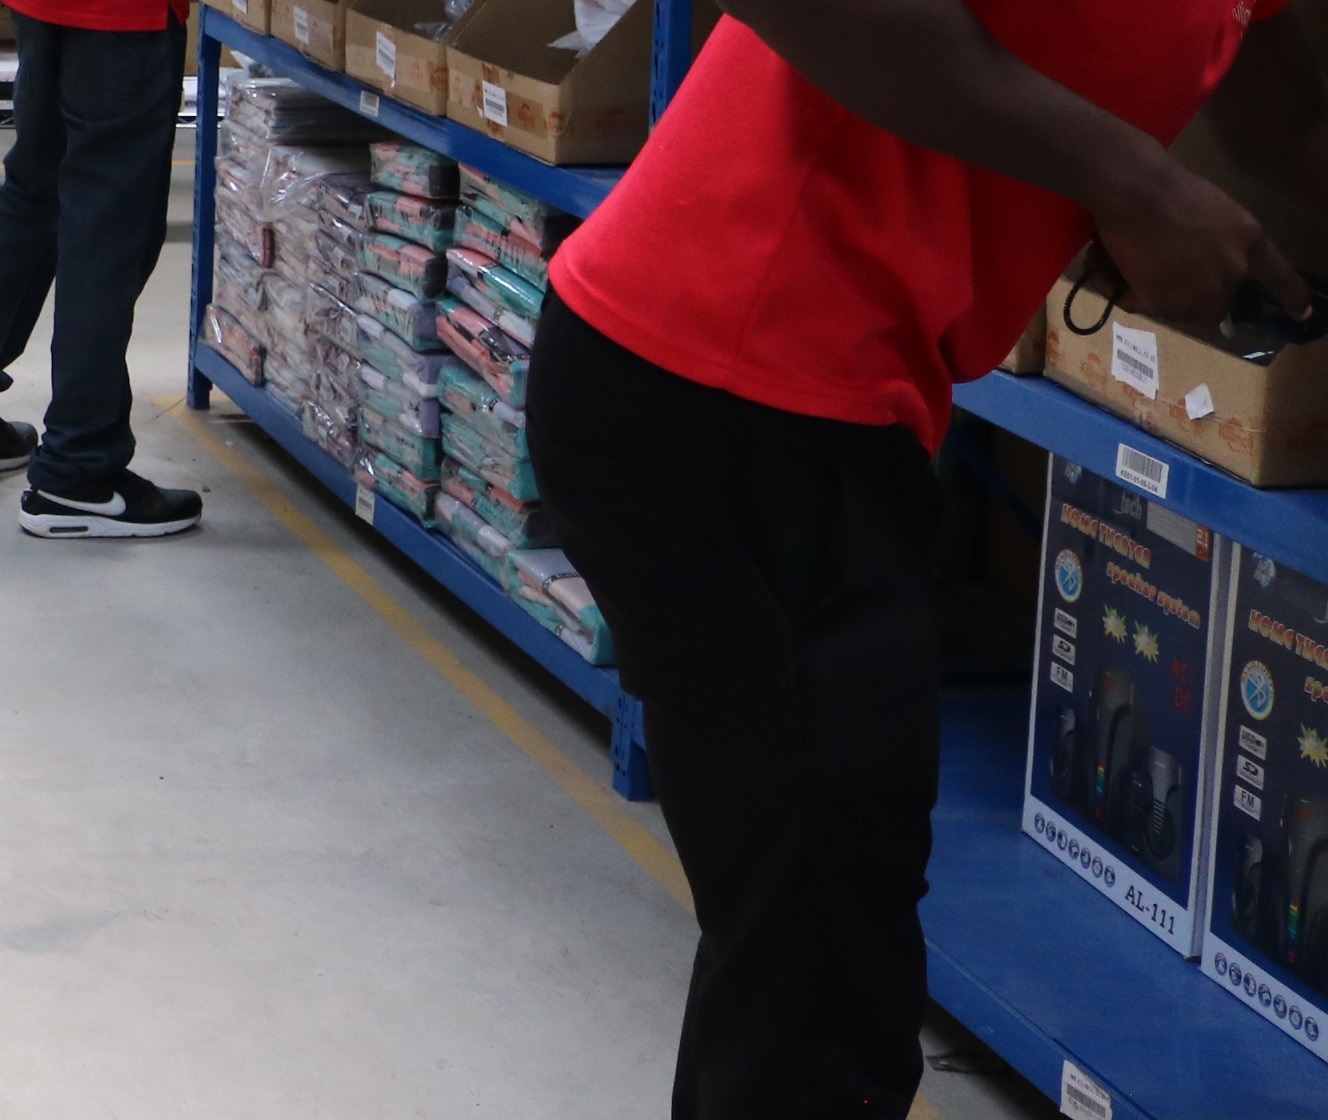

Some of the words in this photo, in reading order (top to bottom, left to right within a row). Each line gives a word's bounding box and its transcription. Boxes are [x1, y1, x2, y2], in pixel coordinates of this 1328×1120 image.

[1056, 665, 1068, 677] FM
[1240, 790, 1255, 807] FM
[1124, 885, 1176, 935] AL-111
